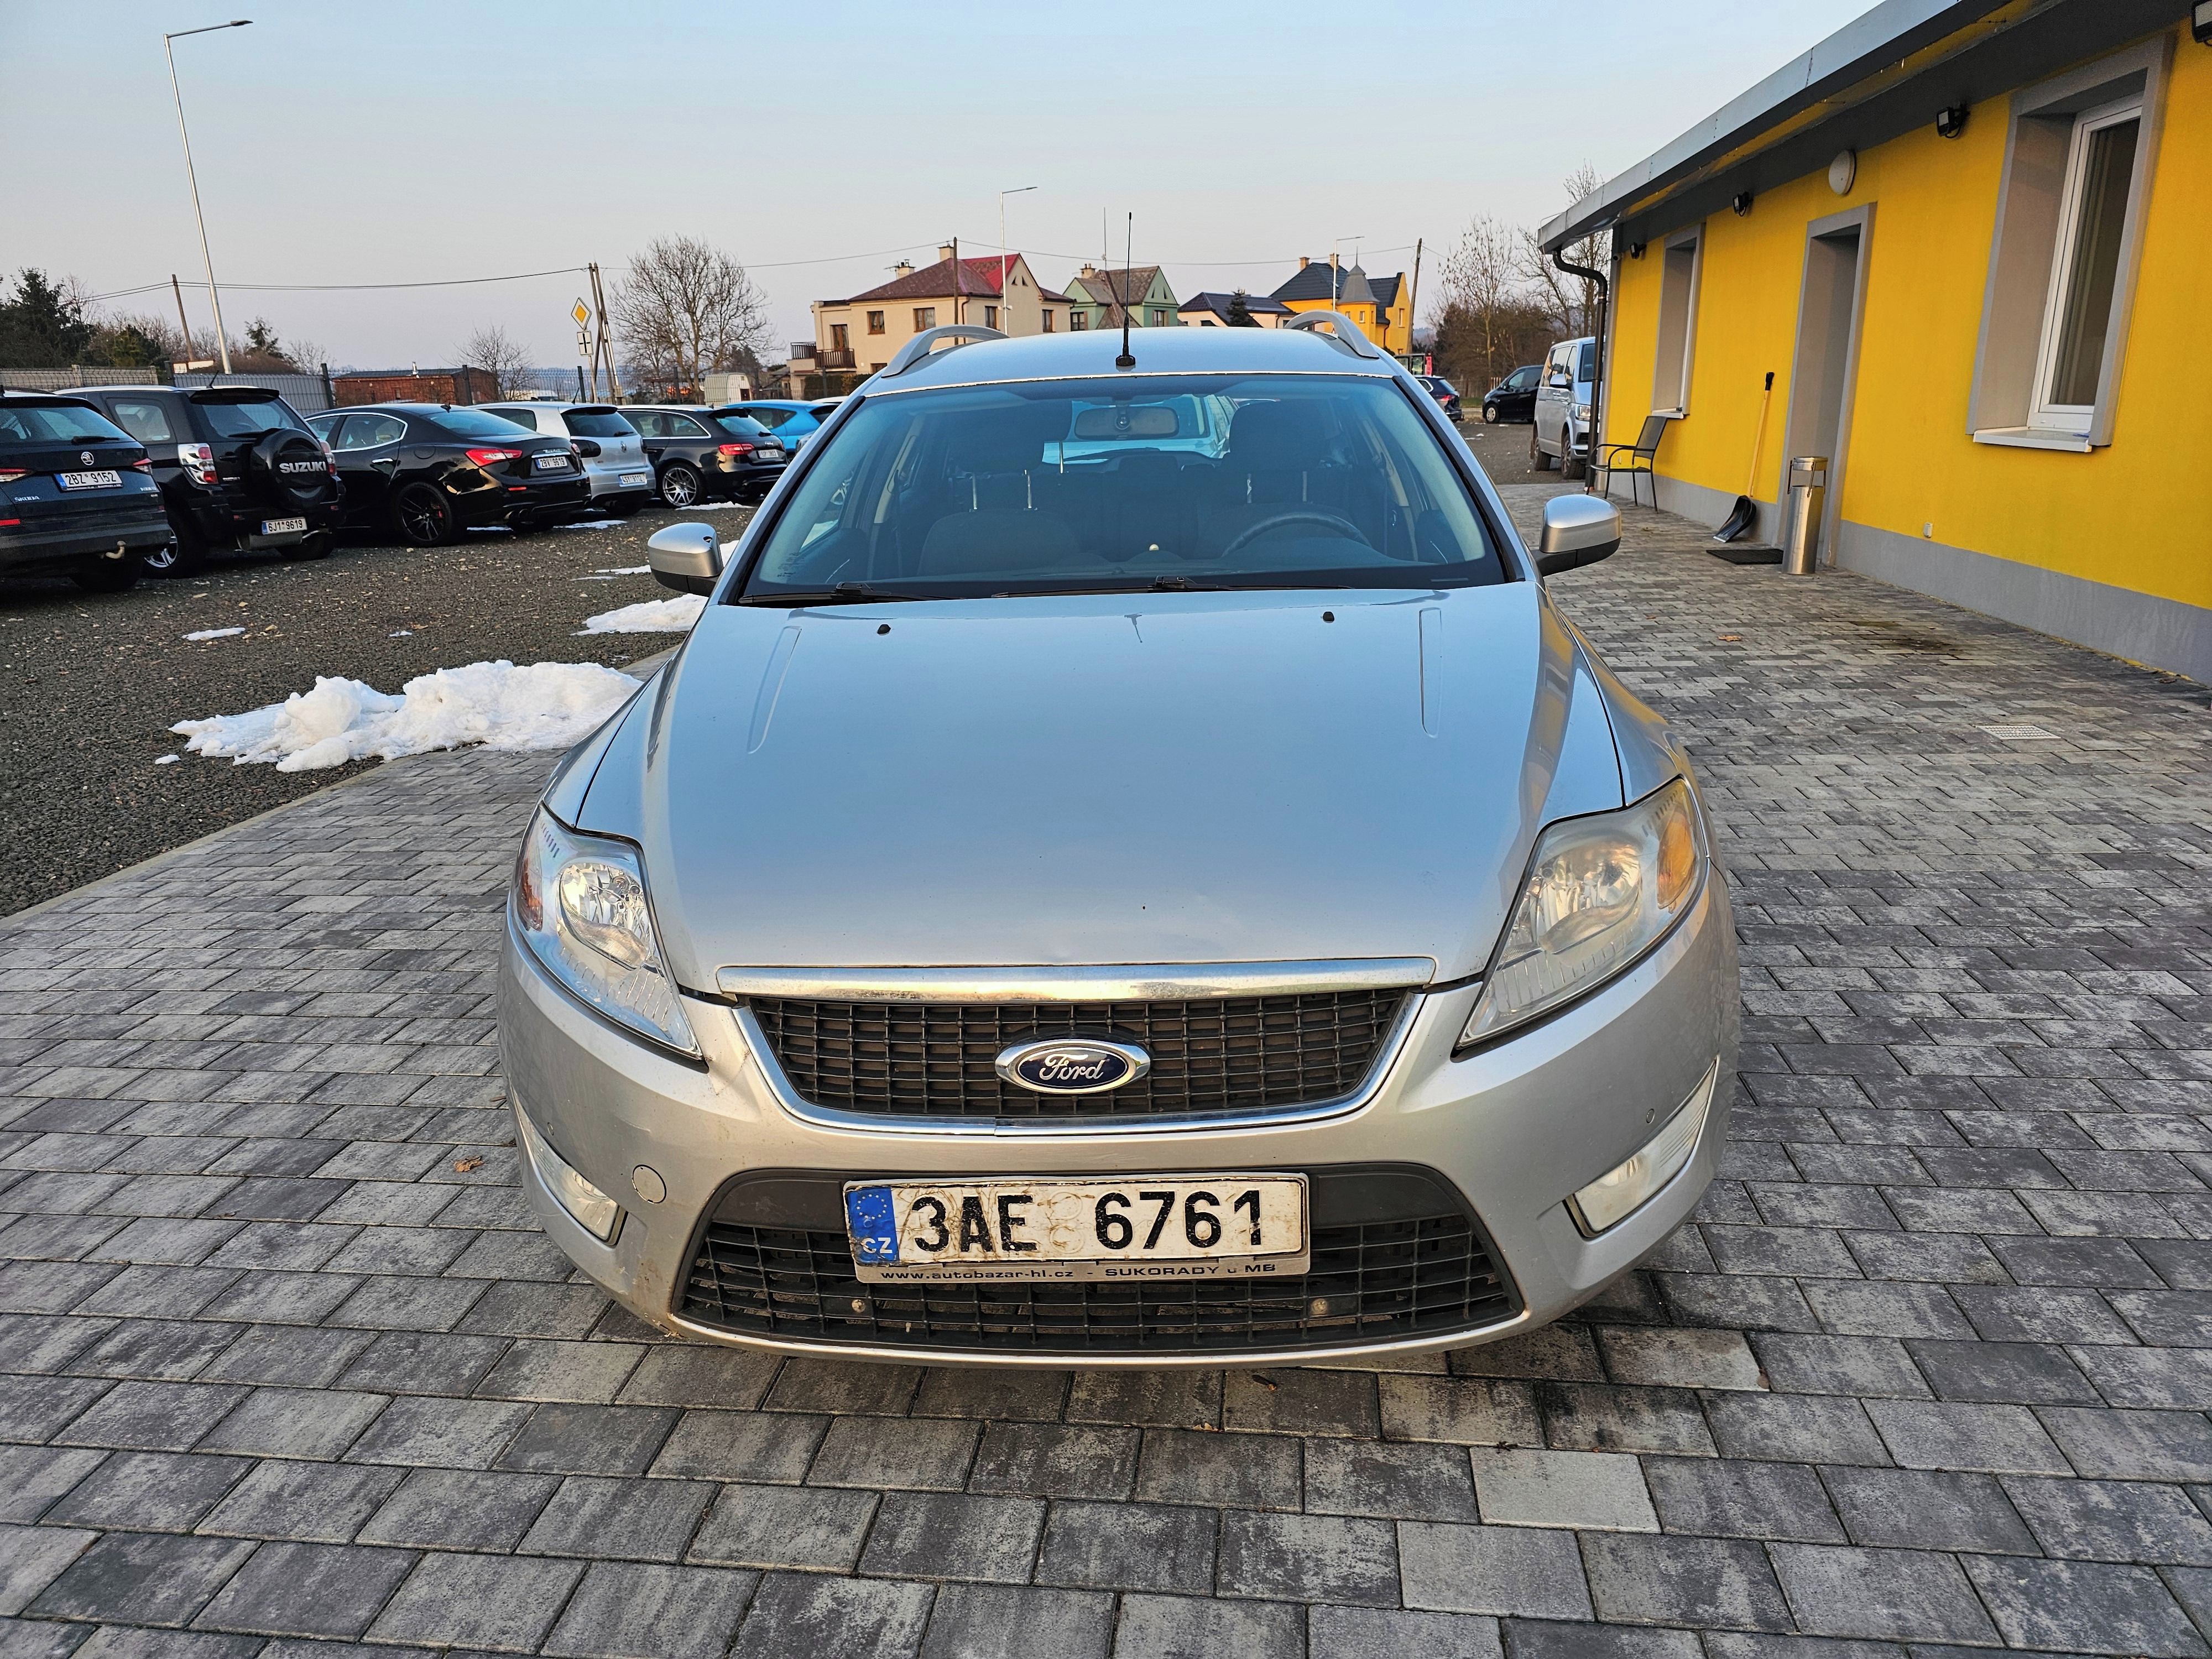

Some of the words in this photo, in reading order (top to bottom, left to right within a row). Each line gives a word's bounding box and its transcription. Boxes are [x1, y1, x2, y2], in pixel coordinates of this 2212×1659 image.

[279, 461, 327, 474] SUZUKI
[65, 473, 86, 485] 2BZ
[91, 472, 117, 483] 9152
[268, 521, 281, 532] 6J1
[286, 519, 302, 530] 9619
[1039, 1053, 1106, 1081] Ford
[911, 1193, 1039, 1253] 3AE
[1094, 1190, 1262, 1250] 6761
[862, 1237, 893, 1254] CZ
[881, 1269, 1074, 1279] www.autobazar-hl.cz
[1105, 1266, 1220, 1277] SUKORADY
[1244, 1264, 1276, 1273] MB
